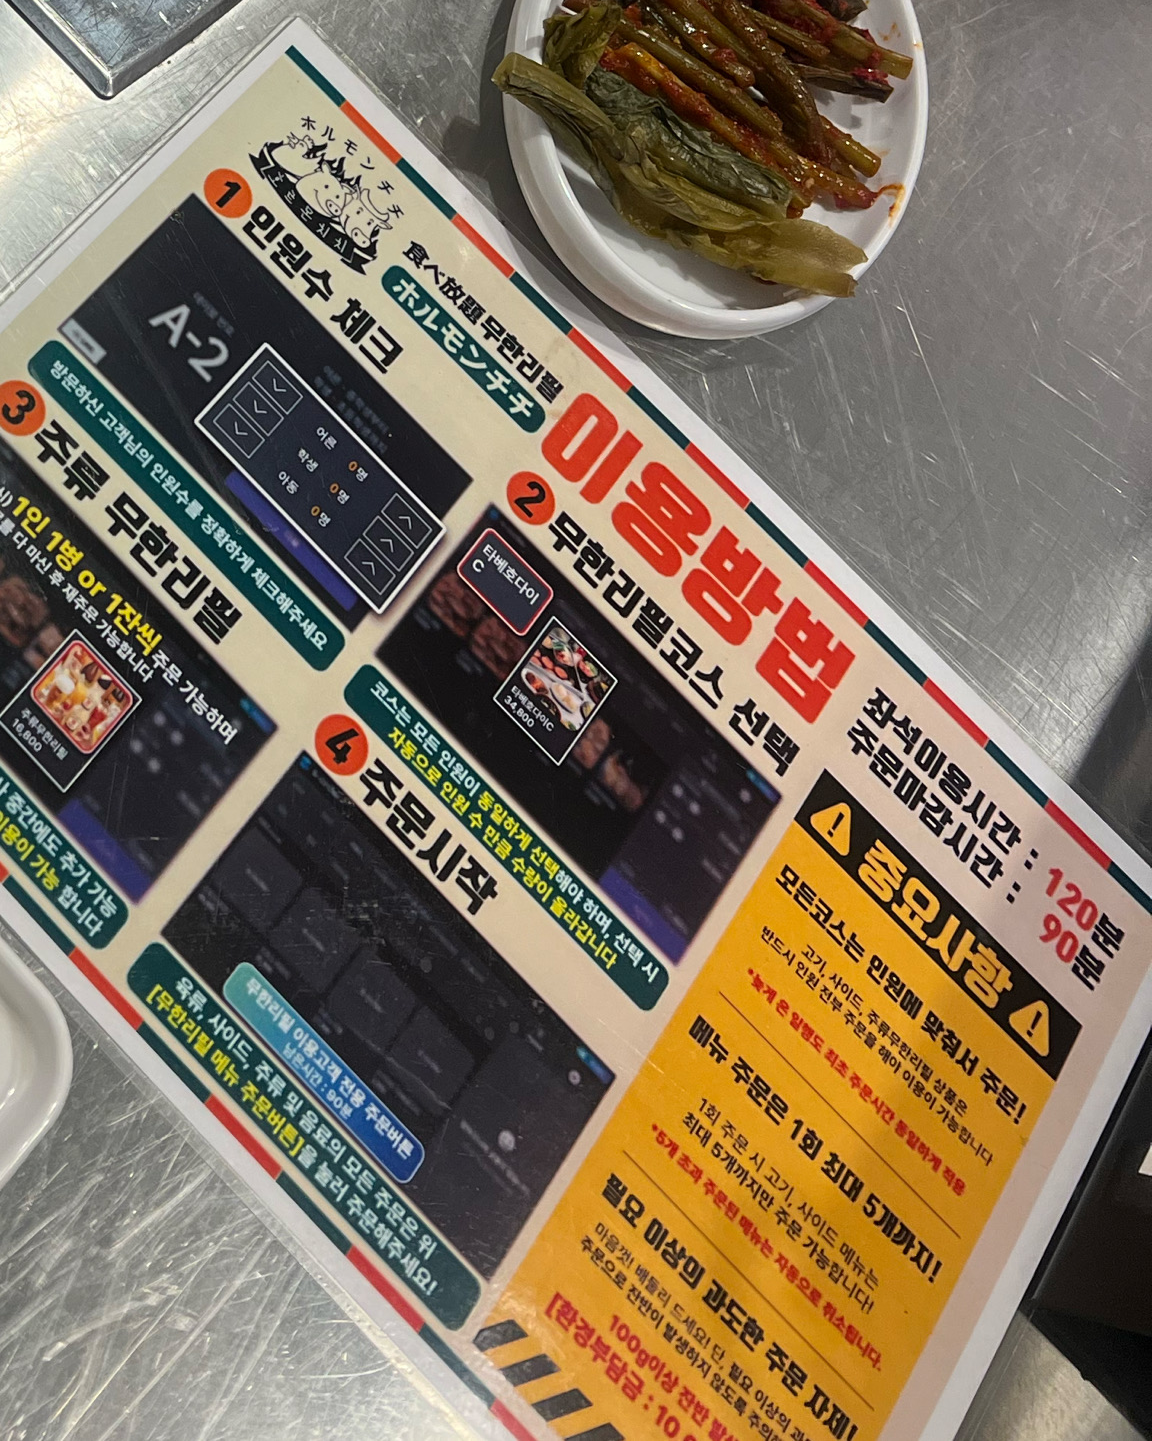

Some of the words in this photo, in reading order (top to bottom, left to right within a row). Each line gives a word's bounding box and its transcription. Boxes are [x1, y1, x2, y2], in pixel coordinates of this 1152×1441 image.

[148, 300, 230, 383] A-2
[213, 179, 242, 209] 1
[241, 205, 336, 305] 인원수
[329, 296, 404, 375] 체크
[391, 277, 535, 420] ホルモンチチ
[0, 388, 37, 428] 3
[30, 418, 111, 504] 주류
[101, 490, 242, 645] 무한리필
[49, 359, 104, 417] 방문하신
[98, 411, 154, 469] 고객님의
[148, 462, 203, 520] 인원수를
[199, 513, 255, 574] 정확하게
[250, 566, 329, 651] 체크해주세요
[277, 471, 299, 495] 아동
[310, 505, 331, 528] 0명
[296, 447, 318, 473] 학생
[315, 426, 337, 451] 어른
[10, 495, 50, 539] 1인
[44, 530, 84, 573] 1병
[76, 567, 108, 599] or
[103, 592, 163, 657] 1잔씩
[150, 649, 183, 687] 주문
[178, 679, 237, 745] 가능하며
[24, 544, 52, 575] 마신
[47, 569, 65, 588] 후
[61, 583, 99, 625] 재주문
[95, 618, 154, 683] 가능합니다
[472, 558, 485, 573] C
[481, 543, 539, 605] 타베호다이
[513, 480, 546, 520] 2
[546, 509, 727, 710] 무한리필코스
[728, 695, 800, 777] 선택
[539, 390, 856, 726] 이용방법
[11, 718, 43, 753] 16,800
[20, 707, 69, 761] 주류무한리필
[503, 695, 534, 728] 34,800
[510, 685, 554, 732] 타베호다이C
[5, 791, 63, 858] 중간에도
[58, 850, 92, 889] 추가
[86, 881, 119, 919] 가능
[29, 853, 61, 891] 가능
[57, 884, 104, 937] 합니다
[323, 725, 360, 774] 4
[356, 756, 499, 918] 주문시작
[369, 680, 412, 728] 코스는
[409, 721, 441, 756] 모든
[437, 750, 480, 798] 인원이
[477, 790, 532, 852] 동일하게
[529, 844, 584, 906] 선택해야
[581, 897, 614, 940] 하며,
[613, 931, 644, 968] 선택
[640, 960, 659, 983] 시
[387, 726, 442, 787] 자동으로
[439, 781, 470, 817] 인원
[467, 811, 484, 830] 수
[482, 824, 513, 861] 만큼
[510, 856, 553, 903] 수량이
[549, 895, 618, 970] 올라갑니다
[845, 718, 1004, 890] 주문마감시간
[1038, 911, 1106, 992] 90분
[862, 686, 1022, 856] 좌석이용시간
[1044, 866, 1125, 960] 120분
[775, 864, 866, 964] 모든코스는
[866, 954, 923, 1020] 인원에
[921, 1010, 979, 1077] 맞춰서
[978, 1066, 1026, 1125] 주문!
[856, 837, 1014, 1012] 중요사항
[174, 975, 209, 1021] 육류,
[206, 1012, 254, 1070] 사이드,
[253, 1059, 286, 1099] 주류
[298, 1108, 346, 1164] 음료의
[341, 1154, 376, 1196] 모든
[373, 1186, 419, 1242] 주문은
[417, 1233, 437, 1260] 위
[245, 977, 295, 1035] 무한리필
[292, 1027, 342, 1084] 이용고객
[339, 1076, 366, 1109] 전용
[364, 1102, 414, 1160] 주문버튼
[282, 1042, 321, 1088] 남은시간
[326, 1088, 353, 1120] 90분
[761, 925, 795, 966] 반드시
[795, 961, 819, 990] 인원
[819, 984, 843, 1014] 전부
[843, 1009, 877, 1049] 주문을
[878, 1045, 901, 1074] 해야
[902, 1069, 936, 1110] 이용이
[936, 1104, 993, 1167] 가능합니다
[787, 1011, 824, 1054] 일행도
[824, 1048, 849, 1078] 최초
[849, 1072, 895, 1126] 주문시간
[893, 1118, 941, 1175] 동일하게
[942, 1165, 965, 1197] 적용
[801, 944, 827, 977] 고기,
[828, 972, 865, 1016] 사이드,
[867, 1009, 933, 1083] 주류무한리필
[933, 1077, 968, 1118] 상품은
[145, 983, 214, 1058] [무한리필
[209, 1049, 241, 1089] 메뉴
[239, 1080, 318, 1169] 주문버튼]을
[314, 1160, 349, 1203] 눌러
[345, 1193, 438, 1297] 주문해주세요!
[677, 1152, 703, 1184] 초과
[701, 1176, 741, 1224] 주문된
[738, 1215, 774, 1258] 메뉴는
[772, 1252, 822, 1308] 자동으로
[682, 1111, 712, 1148] 최대
[711, 1141, 775, 1212] 5개까지만
[774, 1205, 803, 1242] 주문
[802, 1235, 874, 1315] 가능합니다!
[688, 1014, 730, 1065] 메뉴
[730, 1055, 789, 1126] 주문은
[789, 1117, 823, 1161] 1회
[821, 1151, 864, 1203] 최대
[863, 1192, 942, 1283] 5개까지!
[698, 1097, 721, 1127] 1회
[720, 1119, 749, 1156] 주문
[748, 1151, 765, 1173] 시
[763, 1166, 795, 1207] 고기,
[797, 1200, 839, 1249] 사이드
[839, 1242, 879, 1291] 메뉴는
[545, 1291, 645, 1403] [환경부담금
[580, 1235, 627, 1291] 주문으로
[626, 1284, 664, 1330] 잔반이
[662, 1322, 711, 1379] 발생하지
[710, 1372, 748, 1417] 않도록
[594, 1222, 635, 1270] 마음껏!
[670, 1302, 711, 1350] 드세요!
[728, 1362, 753, 1394] 필요
[754, 1389, 791, 1433] 이상의
[601, 1173, 645, 1229] 필요
[643, 1217, 705, 1290] 이상의
[702, 1278, 765, 1353] 과도한
[764, 1340, 808, 1397] 주문
[608, 1314, 679, 1395] 100g이상
[677, 1386, 709, 1427] 잔반
